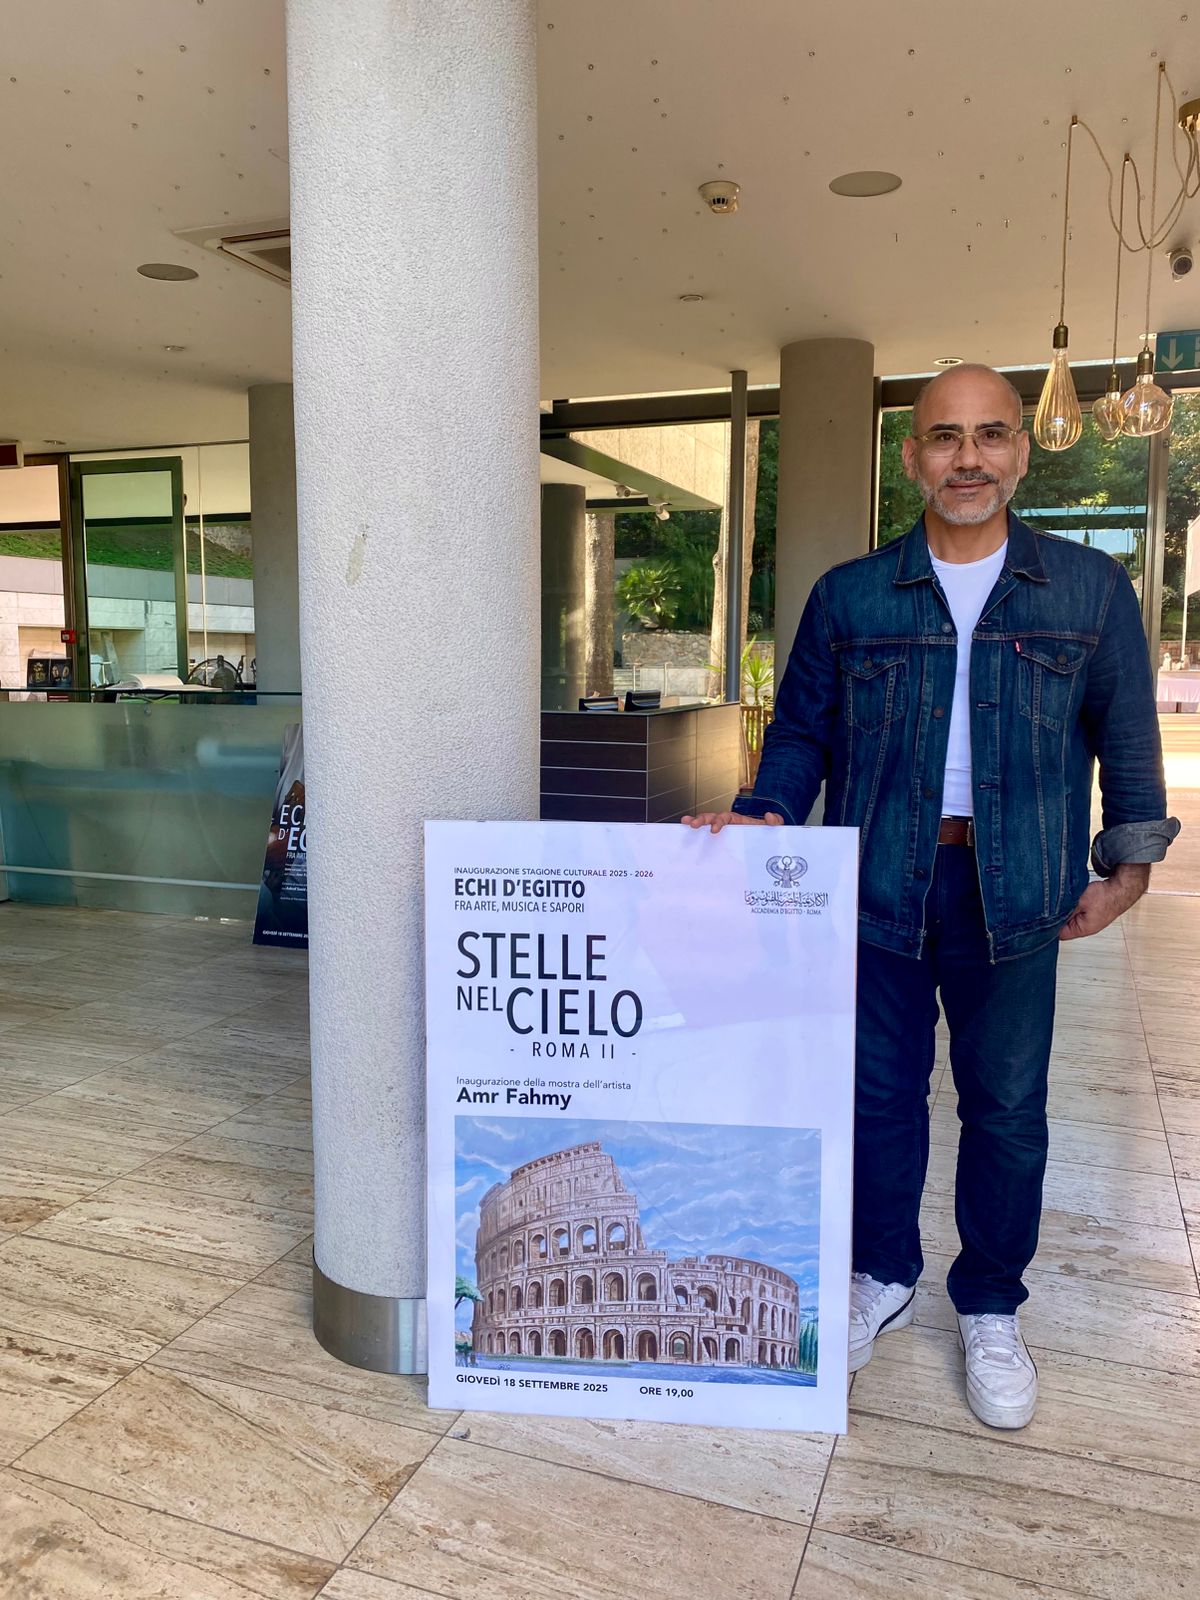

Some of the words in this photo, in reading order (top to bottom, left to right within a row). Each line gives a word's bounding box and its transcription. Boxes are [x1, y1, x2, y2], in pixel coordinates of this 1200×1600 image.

[280, 804, 306, 826] EC
[454, 867, 520, 875] INAUGURAZIONE
[522, 868, 561, 876] STAGIONE
[563, 869, 608, 877] CULTURALE
[609, 870, 628, 878] 2025
[454, 878, 497, 896] ECHI
[503, 879, 586, 899] D'EGITTO
[454, 900, 473, 911] FRA
[474, 901, 499, 913] ARTE,
[501, 902, 539, 912] MUSICA
[542, 903, 547, 913] E
[550, 903, 585, 913] SAPORI
[456, 931, 607, 981] STELLE
[457, 986, 503, 1011] NEL
[506, 987, 643, 1038] CIELO
[532, 1041, 590, 1058] ROMA
[602, 1044, 614, 1059] II
[456, 1076, 521, 1088] Inaugurazione
[523, 1078, 546, 1087] della
[548, 1080, 580, 1089] mostra
[583, 1080, 632, 1090] dell'artista
[456, 1087, 500, 1104] Amr
[506, 1088, 572, 1111] Fahmy
[456, 1374, 500, 1386] GIOVEDÌ
[503, 1378, 516, 1388] 18
[518, 1379, 580, 1391] SETTEMBRE
[583, 1383, 608, 1393] 2025
[639, 1386, 662, 1396] ORE
[665, 1387, 694, 1398] 19,00
